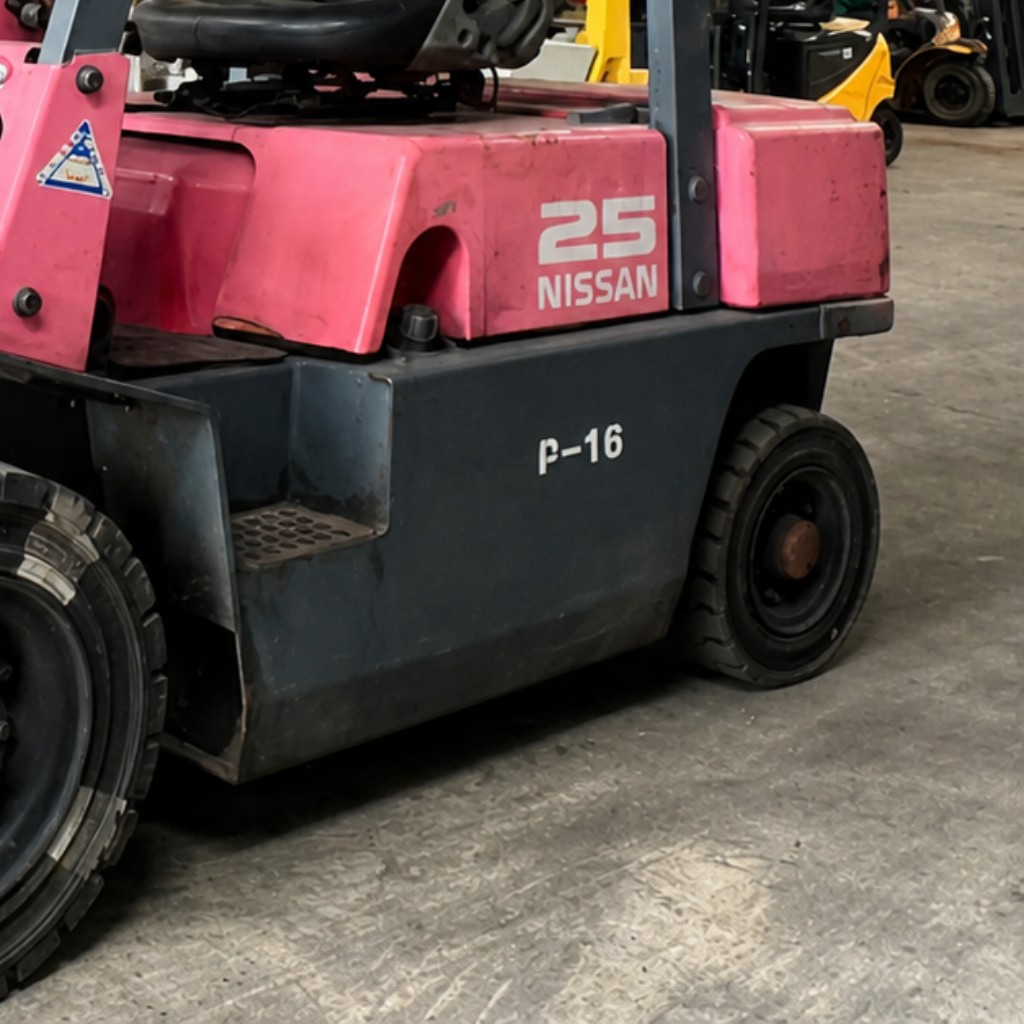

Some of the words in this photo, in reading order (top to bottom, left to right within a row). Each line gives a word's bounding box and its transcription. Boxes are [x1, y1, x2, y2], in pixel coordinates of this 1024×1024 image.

[538, 195, 657, 265] 25
[537, 264, 658, 310] NISSAN
[539, 423, 623, 476] P-16
